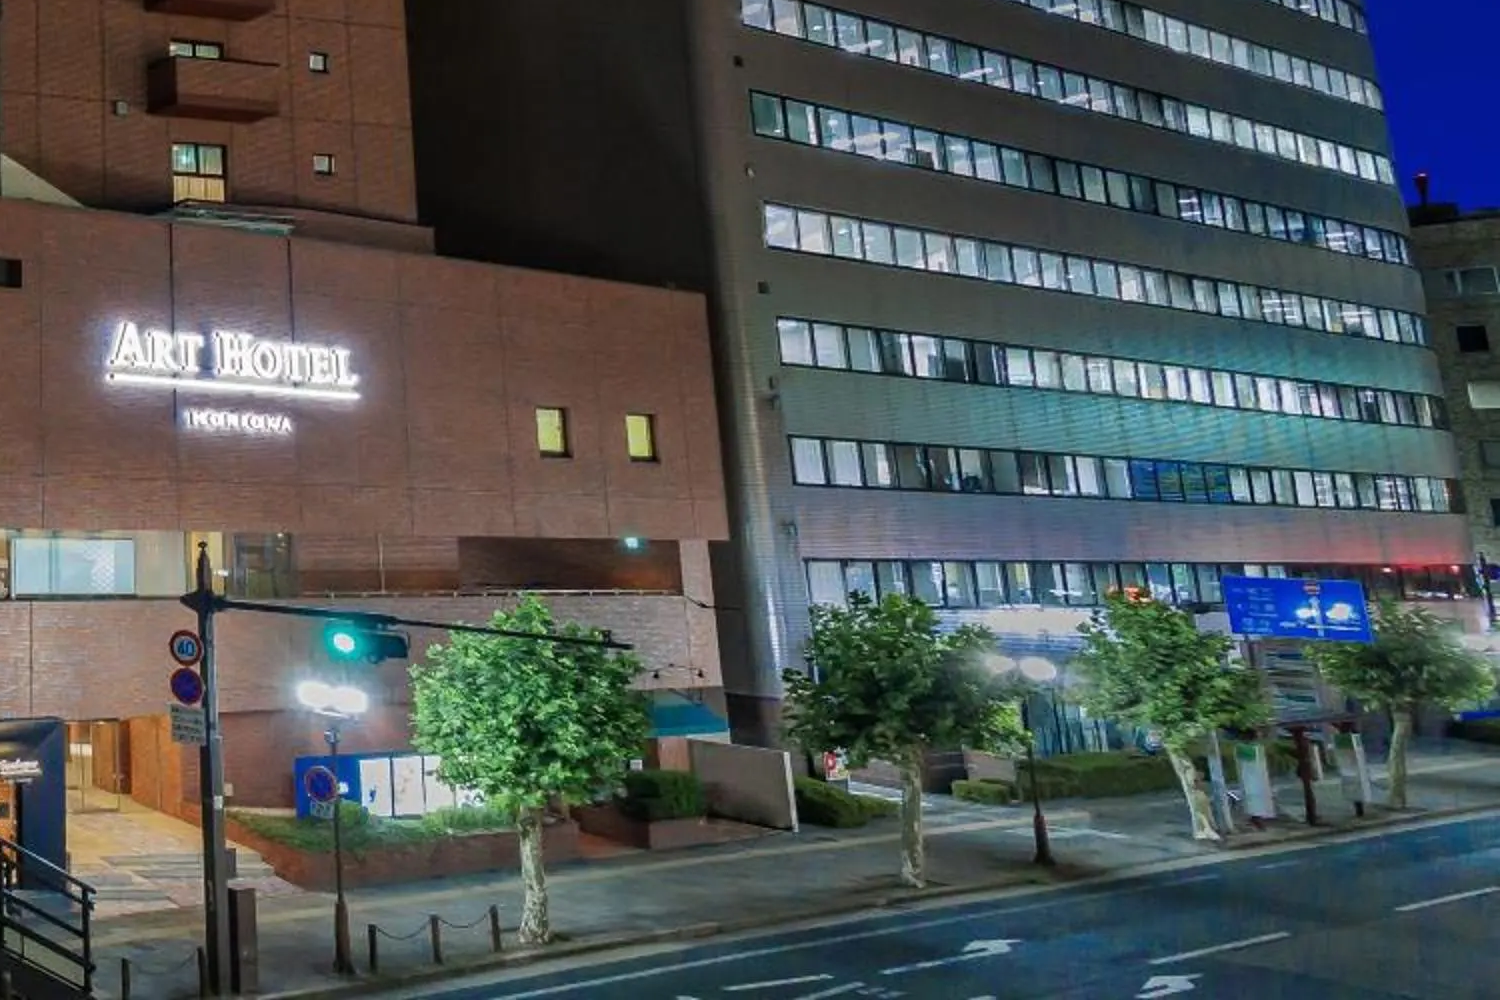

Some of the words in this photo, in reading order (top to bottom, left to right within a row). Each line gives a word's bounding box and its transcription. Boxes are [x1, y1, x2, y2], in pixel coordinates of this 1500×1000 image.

[109, 320, 204, 372] ART
[214, 329, 360, 385] HOTEL
[177, 639, 195, 657] 40
